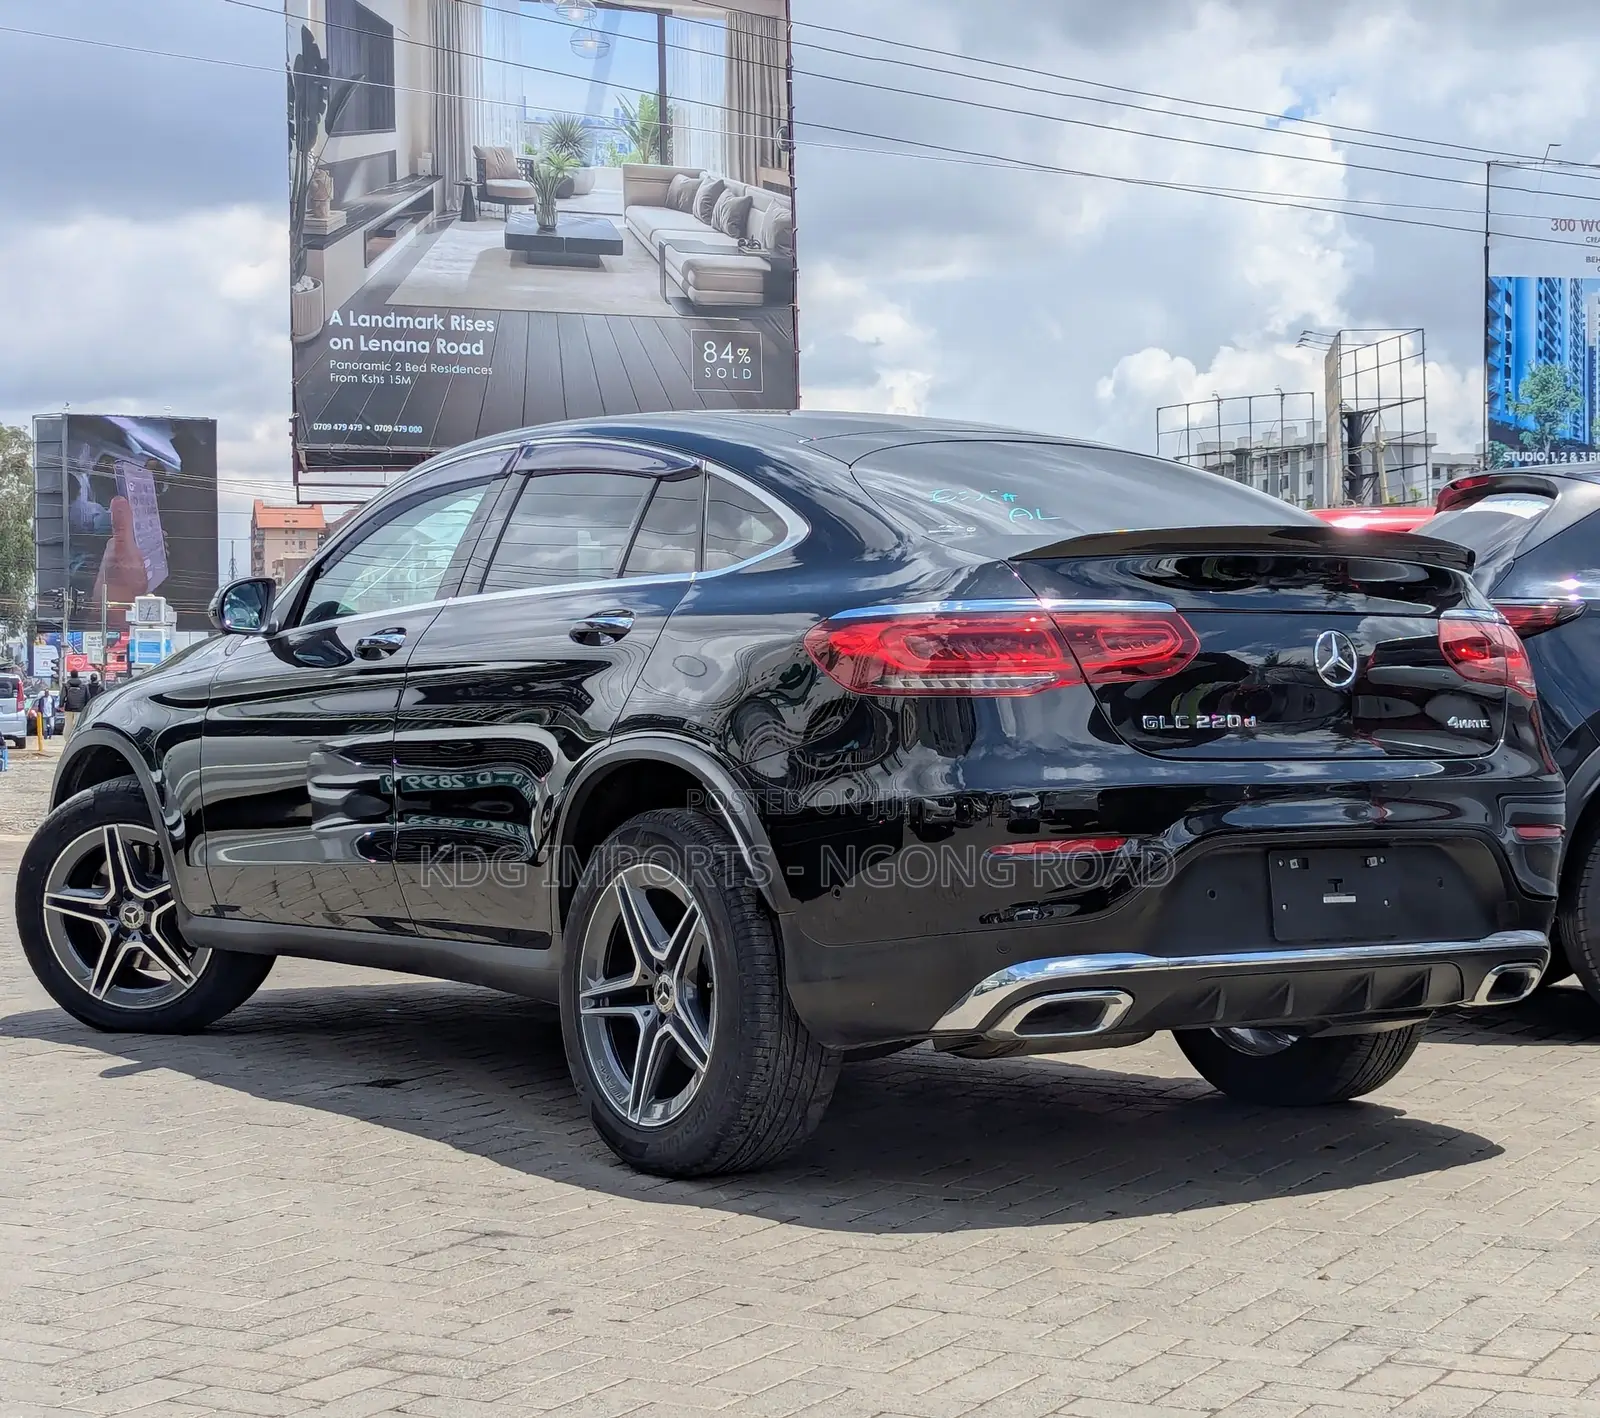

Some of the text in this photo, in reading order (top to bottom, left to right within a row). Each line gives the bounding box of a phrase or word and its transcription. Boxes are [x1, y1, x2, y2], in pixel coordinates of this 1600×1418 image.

[1551, 218, 1576, 231] 300
[329, 310, 495, 332] A Landmark Rises
[329, 335, 484, 355] on Lenana Road
[703, 341, 751, 363] 84%
[329, 359, 493, 375] Panoramic 2 Bed Residences
[705, 367, 752, 379] SOLD
[330, 373, 411, 385] From Kshs 15M
[313, 423, 332, 431] 0709
[333, 423, 347, 431] 479
[348, 424, 363, 432] 479
[374, 424, 392, 432] 0709
[408, 425, 423, 433] 000
[1503, 452, 1548, 464] STUDIO,
[1560, 452, 1567, 462] 2
[1570, 452, 1577, 462] &
[1142, 715, 1190, 729] GLC
